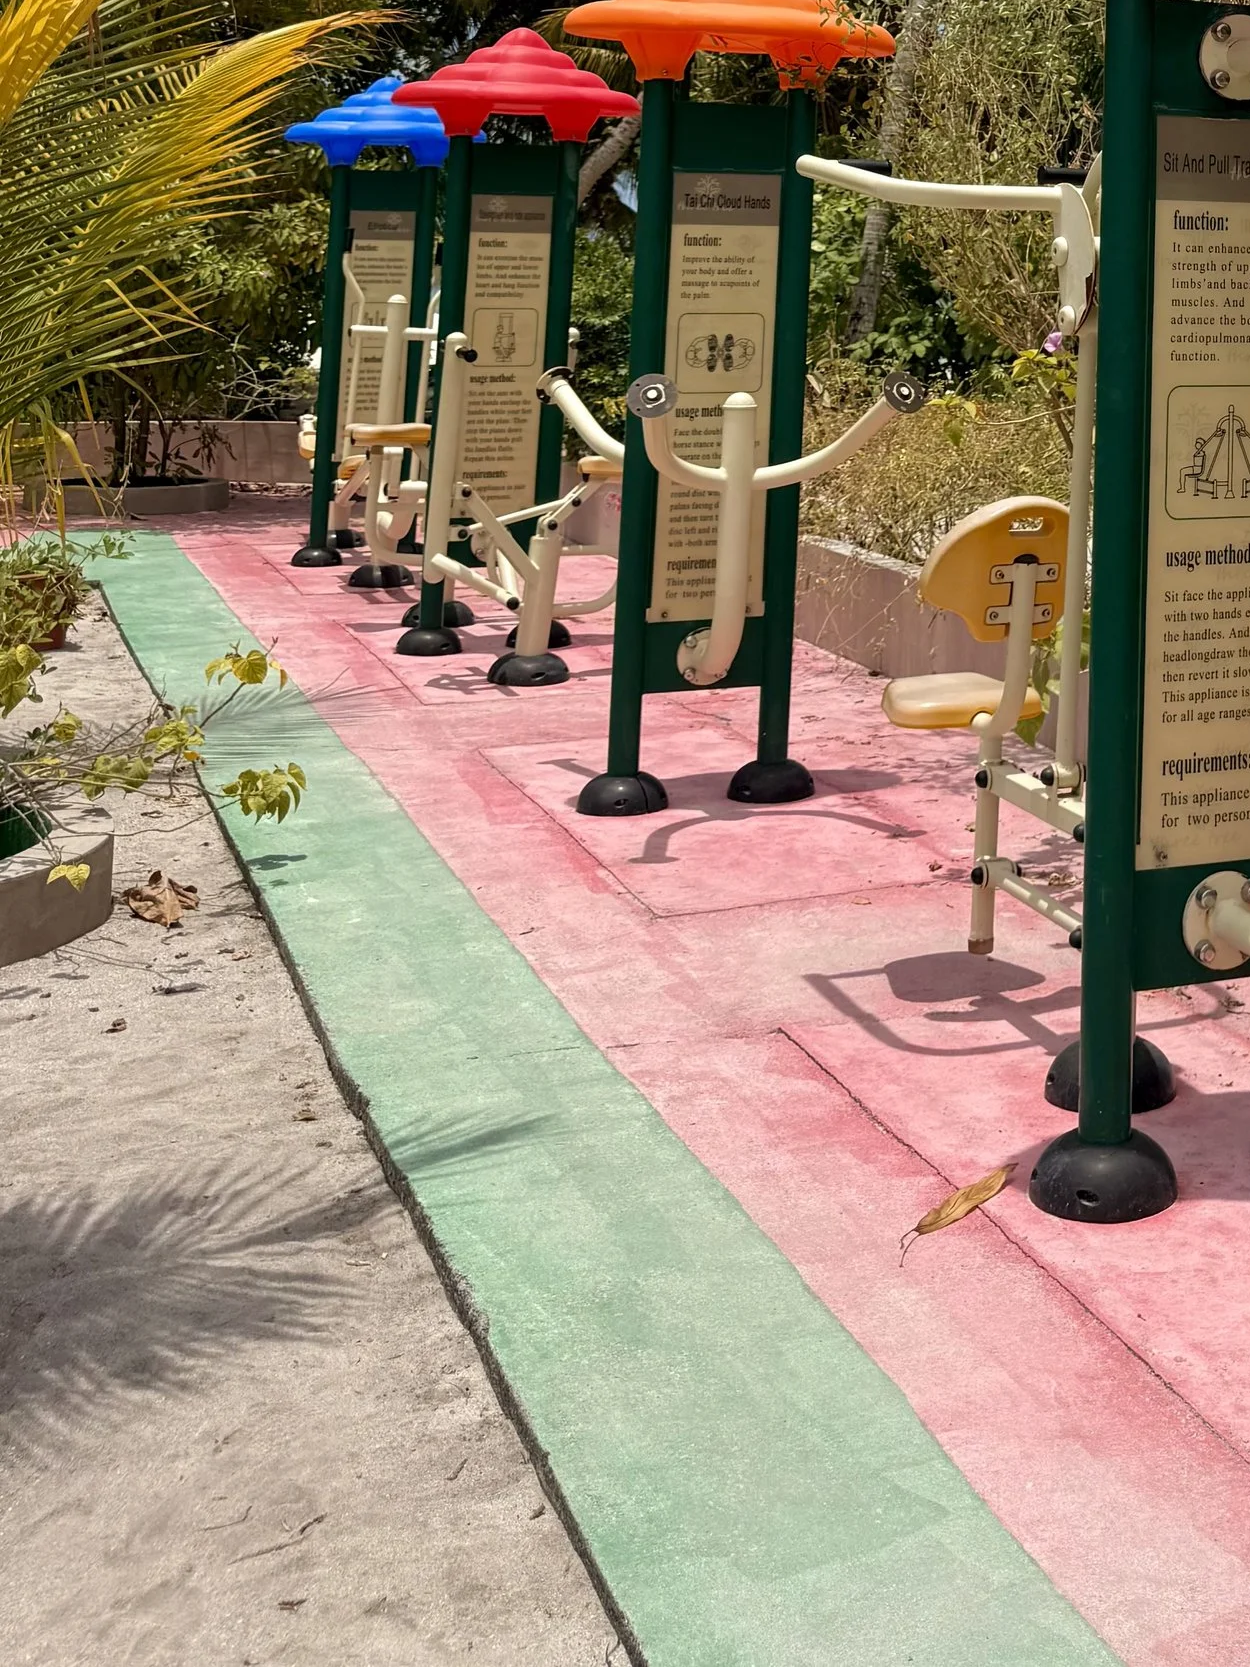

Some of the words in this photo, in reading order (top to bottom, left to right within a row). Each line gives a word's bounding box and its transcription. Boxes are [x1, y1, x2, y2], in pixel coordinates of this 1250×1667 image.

[1163, 152, 1179, 173] Sit
[1182, 153, 1205, 174] And
[1208, 154, 1230, 175] Pull
[684, 194, 698, 208] Tai
[700, 194, 715, 208] Chi
[717, 195, 742, 210] Cloud
[744, 195, 771, 210] Hands
[1173, 209, 1229, 232] function:
[683, 233, 722, 247] function:
[1172, 242, 1181, 254] It
[1185, 243, 1204, 254] can
[711, 255, 722, 263] the
[746, 255, 755, 263] of
[1171, 260, 1217, 274] strength
[1221, 261, 1233, 272] of
[717, 267, 729, 275] and
[1171, 296, 1219, 309] muscles.
[1223, 296, 1245, 308] And
[1170, 314, 1215, 326] advance
[1219, 315, 1237, 326] the
[1169, 349, 1220, 362] function.
[675, 407, 699, 422] usage
[1166, 549, 1201, 573] usage
[1164, 590, 1179, 603] Sit
[1182, 589, 1204, 602] face
[1207, 588, 1223, 600] the
[1164, 610, 1187, 623] with
[1190, 609, 1209, 621] two
[1212, 607, 1242, 620] hands
[1163, 630, 1180, 643] the
[1182, 628, 1225, 642] handles.
[1228, 626, 1250, 639] And
[1162, 647, 1235, 663] headlongdraw
[1162, 670, 1185, 683] then
[1188, 669, 1219, 681] revert
[1222, 667, 1230, 679] it
[1162, 689, 1186, 704] This
[1188, 687, 1238, 704] appliance
[1241, 686, 1250, 697] is
[1161, 710, 1178, 724] for
[1180, 709, 1194, 722] all
[1197, 710, 1216, 725] age
[1160, 790, 1189, 807] This
[1192, 787, 1250, 808] appliance
[1160, 813, 1180, 829] for
[1187, 812, 1210, 827] two
